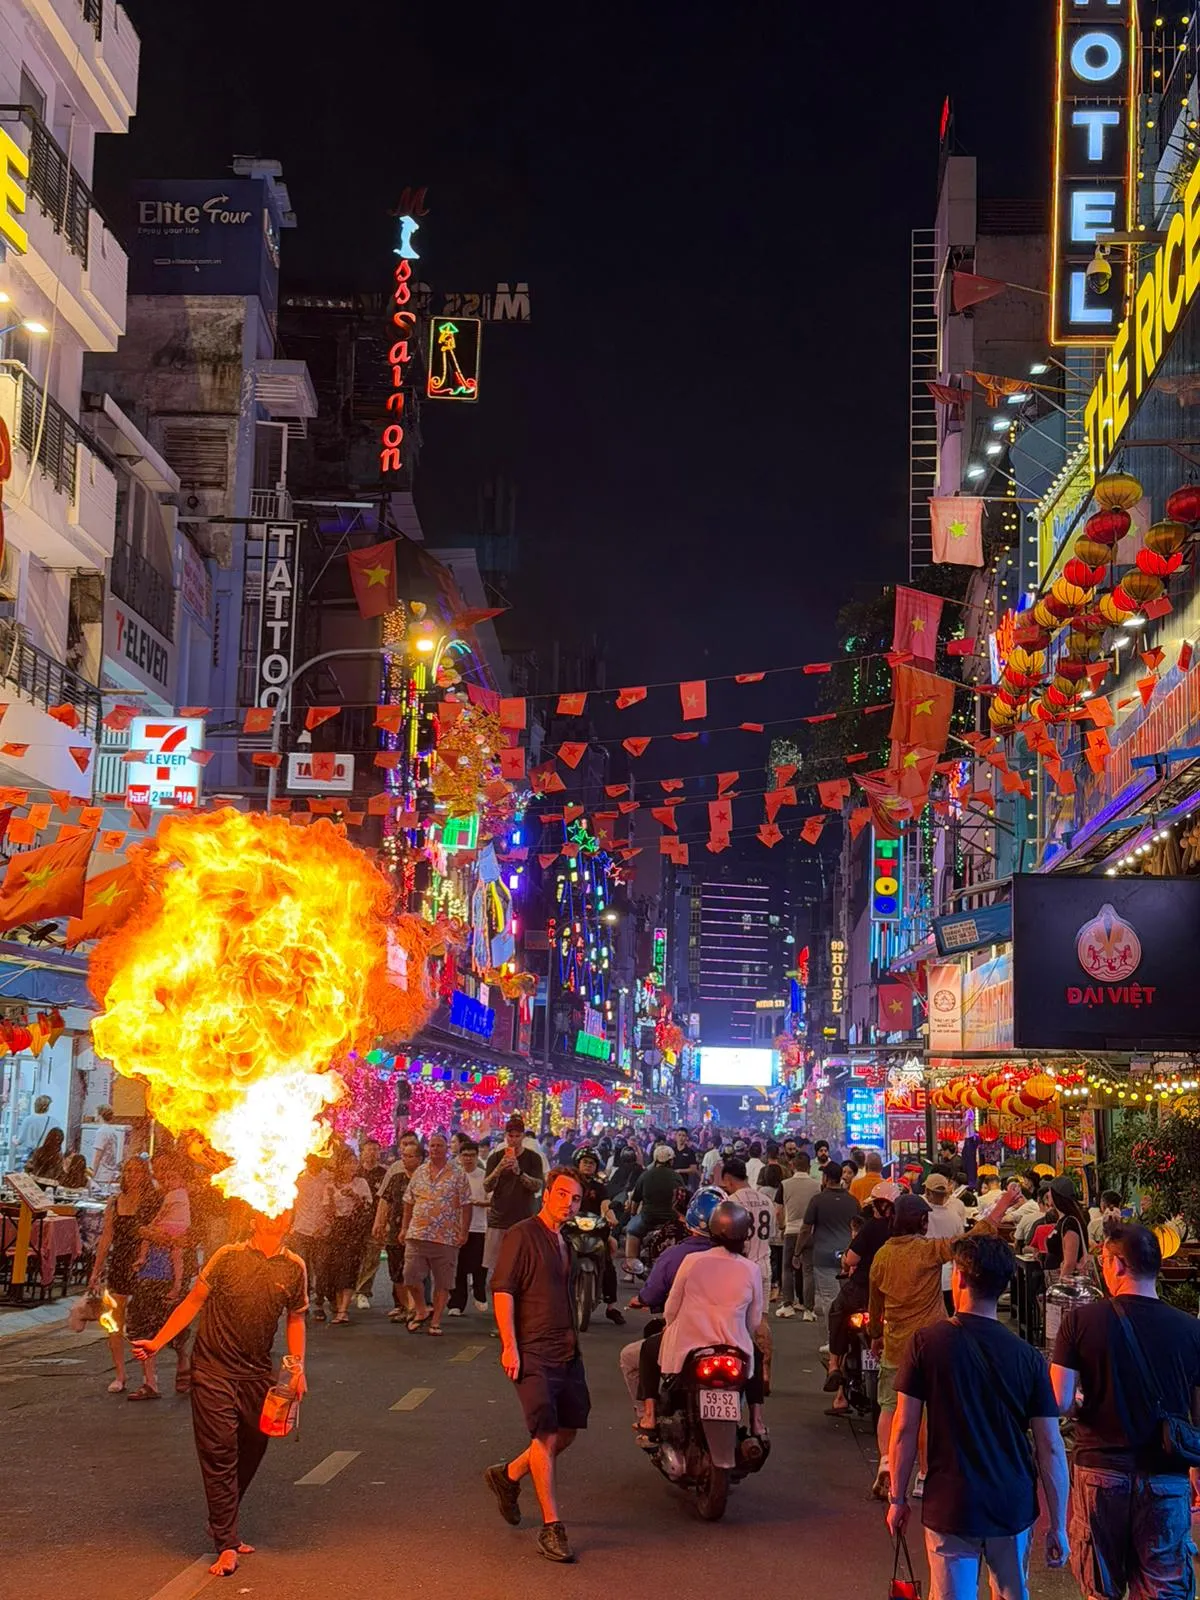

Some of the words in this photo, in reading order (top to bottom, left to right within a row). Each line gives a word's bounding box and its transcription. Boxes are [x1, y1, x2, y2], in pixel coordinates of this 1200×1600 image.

[1070, 0, 1122, 322] OTEL
[139, 201, 200, 224] Elite
[202, 194, 252, 224] Tour
[1084, 318, 1129, 487] THE
[145, 725, 187, 752] 7
[873, 840, 898, 914] TTOO
[831, 941, 844, 951] 99
[831, 952, 844, 1012] HOTEL
[1066, 986, 1104, 1008] ĐẠI
[1107, 982, 1156, 1008] VIỆT
